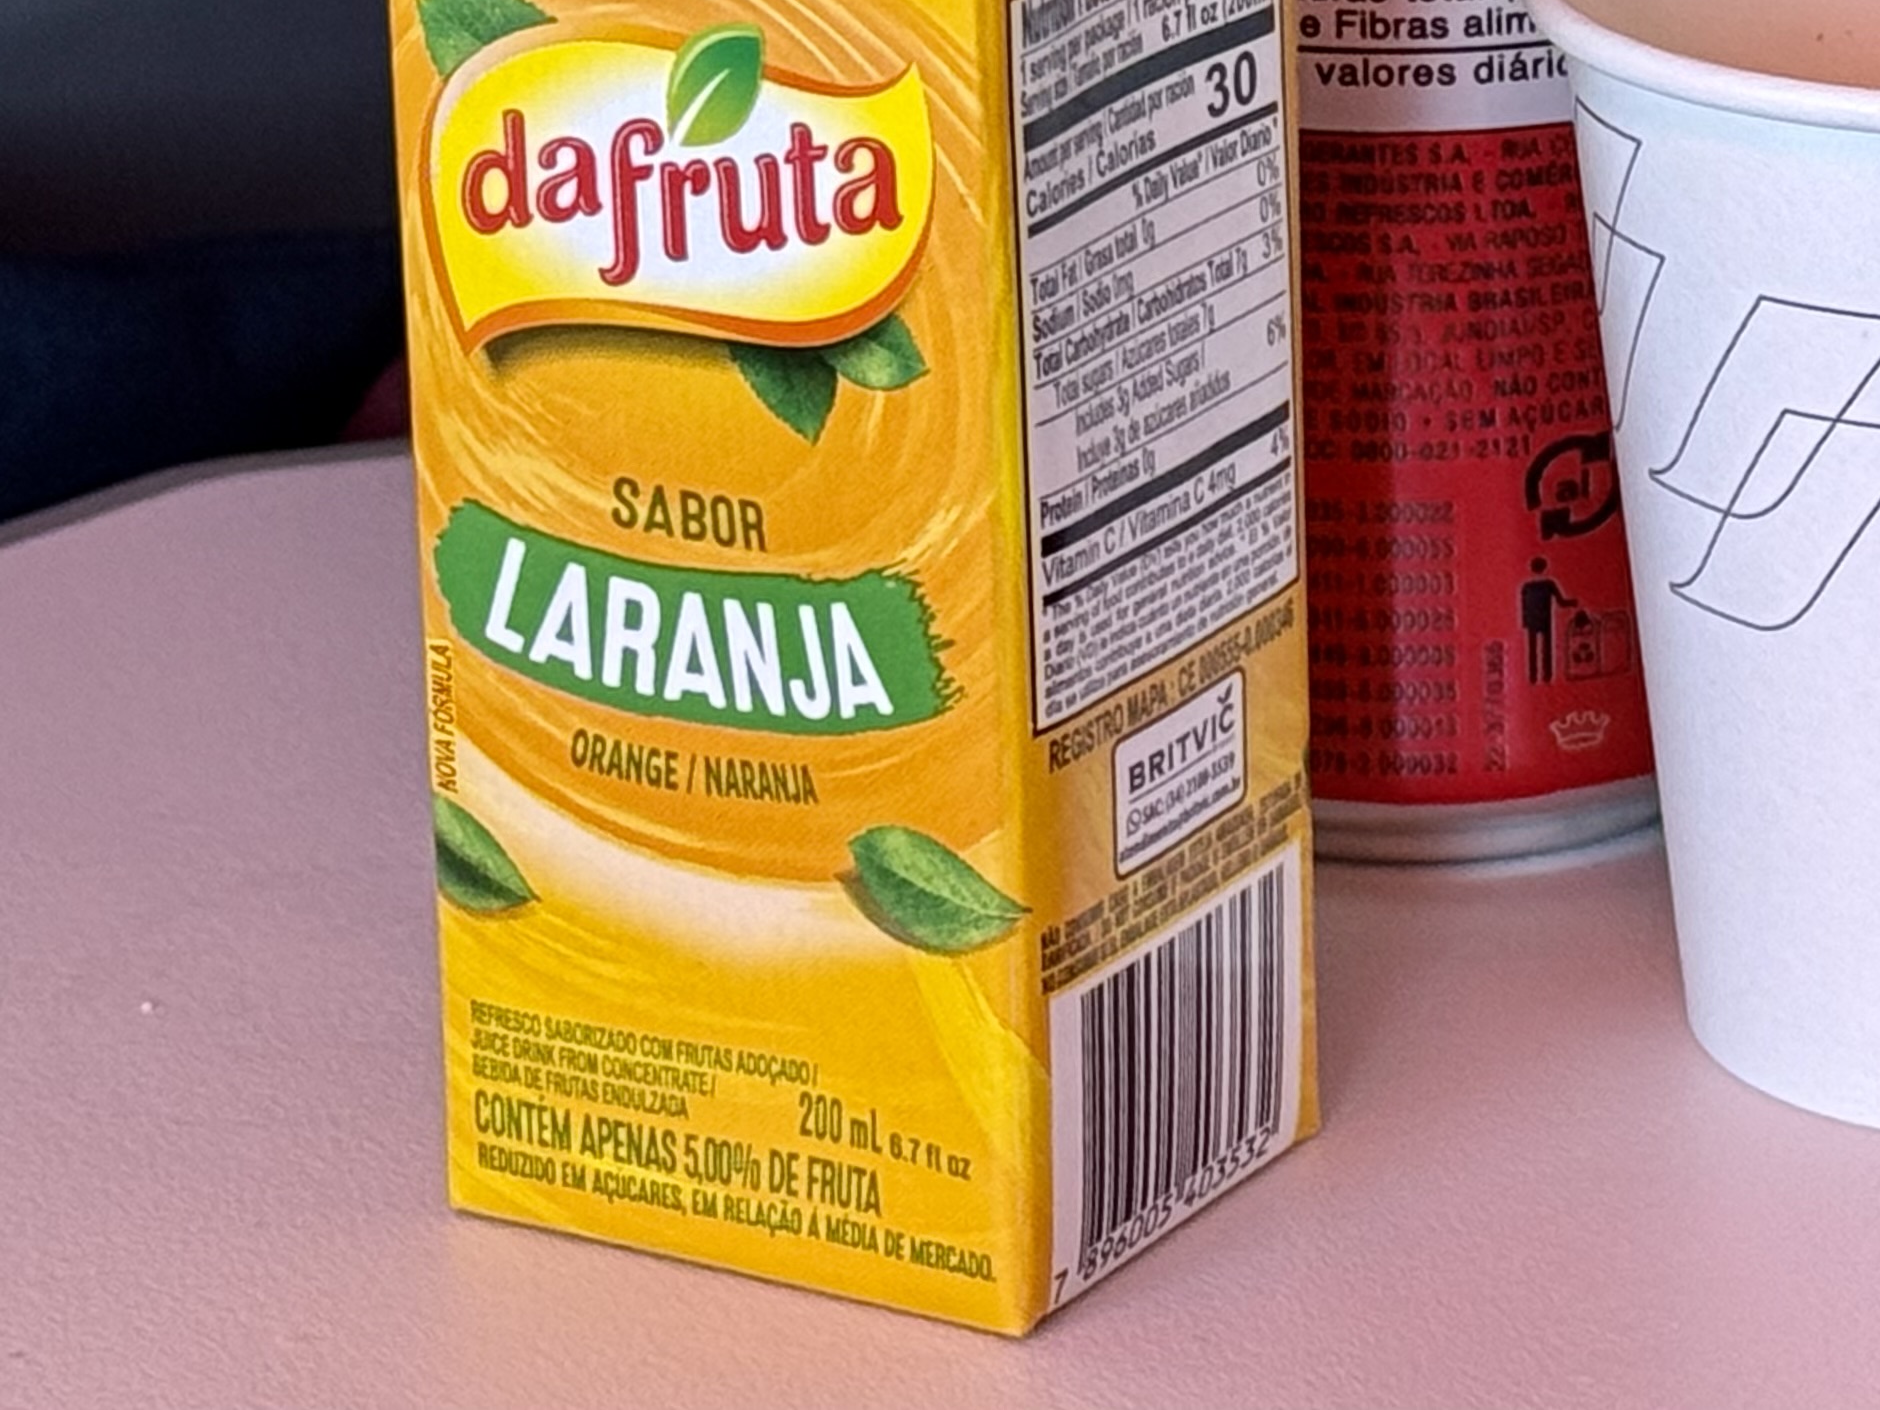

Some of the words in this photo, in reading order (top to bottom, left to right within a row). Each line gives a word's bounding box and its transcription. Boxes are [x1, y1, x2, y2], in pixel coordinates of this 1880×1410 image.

[1161, 11, 1181, 42] 6.7
[1200, 1, 1218, 25] oz
[1335, 8, 1449, 41] Fibras
[1315, 57, 1456, 88] valores
[1026, 167, 1085, 218] Calories
[1095, 130, 1156, 178] Calorías
[1204, 50, 1258, 118] 30
[1496, 161, 1575, 190] COMÉR
[462, 107, 903, 287] dafruta
[611, 476, 767, 553] SABOR
[1042, 540, 1099, 588] Vitamin
[1103, 527, 1117, 556] C
[1127, 488, 1192, 542] Vitamina
[485, 537, 894, 720] LARANJA
[434, 738, 459, 795] NOVA
[571, 728, 679, 792] ORANGE
[704, 754, 819, 805] NARANJA
[1050, 704, 1125, 773] REGISTRO
[1127, 682, 1169, 726] MAPA
[470, 999, 542, 1037] REFRESCO
[544, 1011, 637, 1056] SABORIZADO
[640, 1032, 674, 1062] COM
[676, 1038, 732, 1072] FRUTAS
[736, 1050, 810, 1087] ADOÇADO
[470, 1027, 510, 1056] JUICE
[512, 1037, 556, 1067] DRINK
[558, 1046, 600, 1077] FROM
[601, 1054, 710, 1096] CONCENTRATE
[471, 1053, 522, 1088] BEBIDA
[523, 1065, 544, 1092] DE
[545, 1069, 600, 1104] FRUTAS
[602, 1081, 689, 1122] ENDULZADA
[473, 1086, 572, 1154] CONTÉM
[579, 1111, 678, 1176] APENAS
[768, 1148, 801, 1198] DE
[806, 1154, 882, 1218] FRUTA
[798, 1089, 844, 1144] 200
[888, 1131, 920, 1168] 6.7
[925, 1138, 942, 1173] fl
[948, 1154, 973, 1183] oz
[477, 1140, 556, 1187] REDUZIDO
[560, 1157, 587, 1193] EM
[691, 1185, 720, 1220] EM
[723, 1192, 804, 1239] RELAÇÃO
[825, 1211, 881, 1254] MÉDIA
[884, 1228, 906, 1263] DE
[909, 1234, 998, 1285] MERCADO.
[1053, 1267, 1070, 1305] 7
[1083, 1193, 1173, 1282] 896005
[1184, 1126, 1271, 1208] 403532
